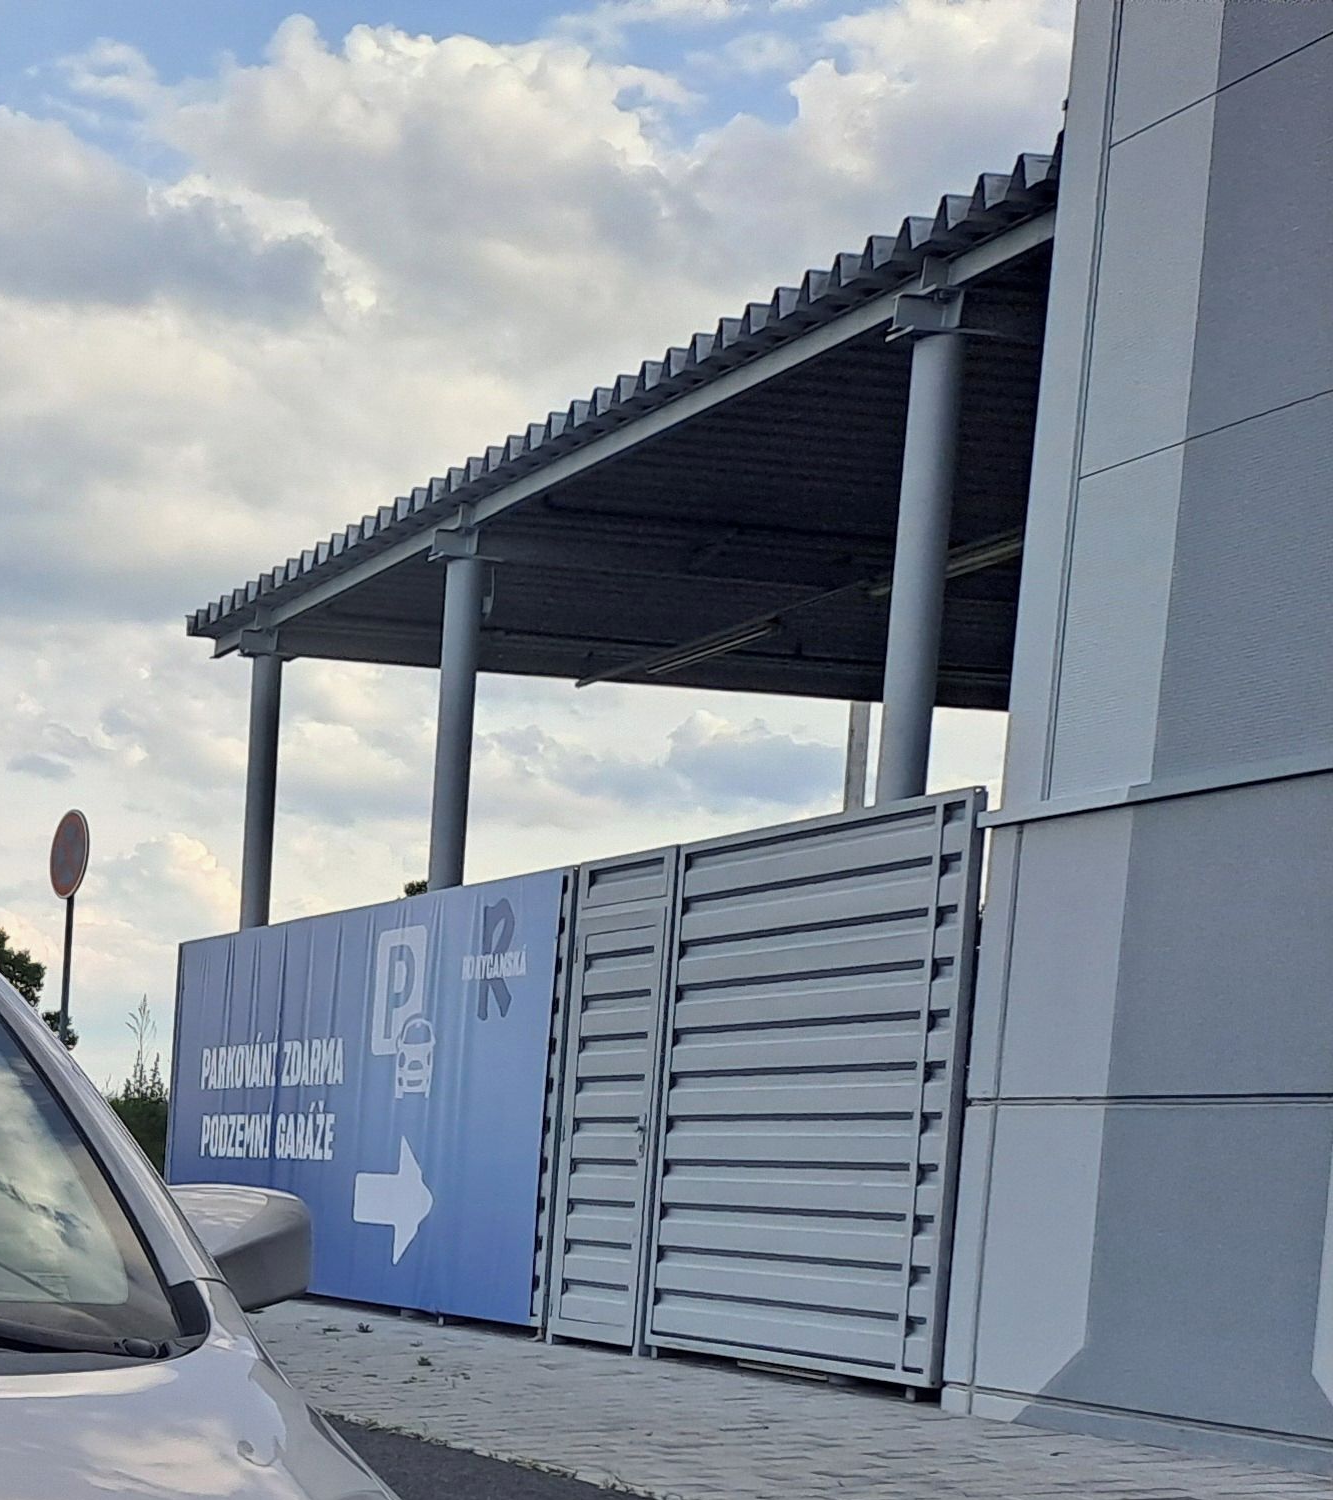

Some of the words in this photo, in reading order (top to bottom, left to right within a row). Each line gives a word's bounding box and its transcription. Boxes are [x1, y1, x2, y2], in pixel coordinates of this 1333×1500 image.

[200, 1030, 279, 1090] PARKOVÁNÍ
[281, 1037, 344, 1087] ZDARMA
[200, 1102, 273, 1159] PODZEMNÍ
[275, 1100, 336, 1161] GARÁŽE
